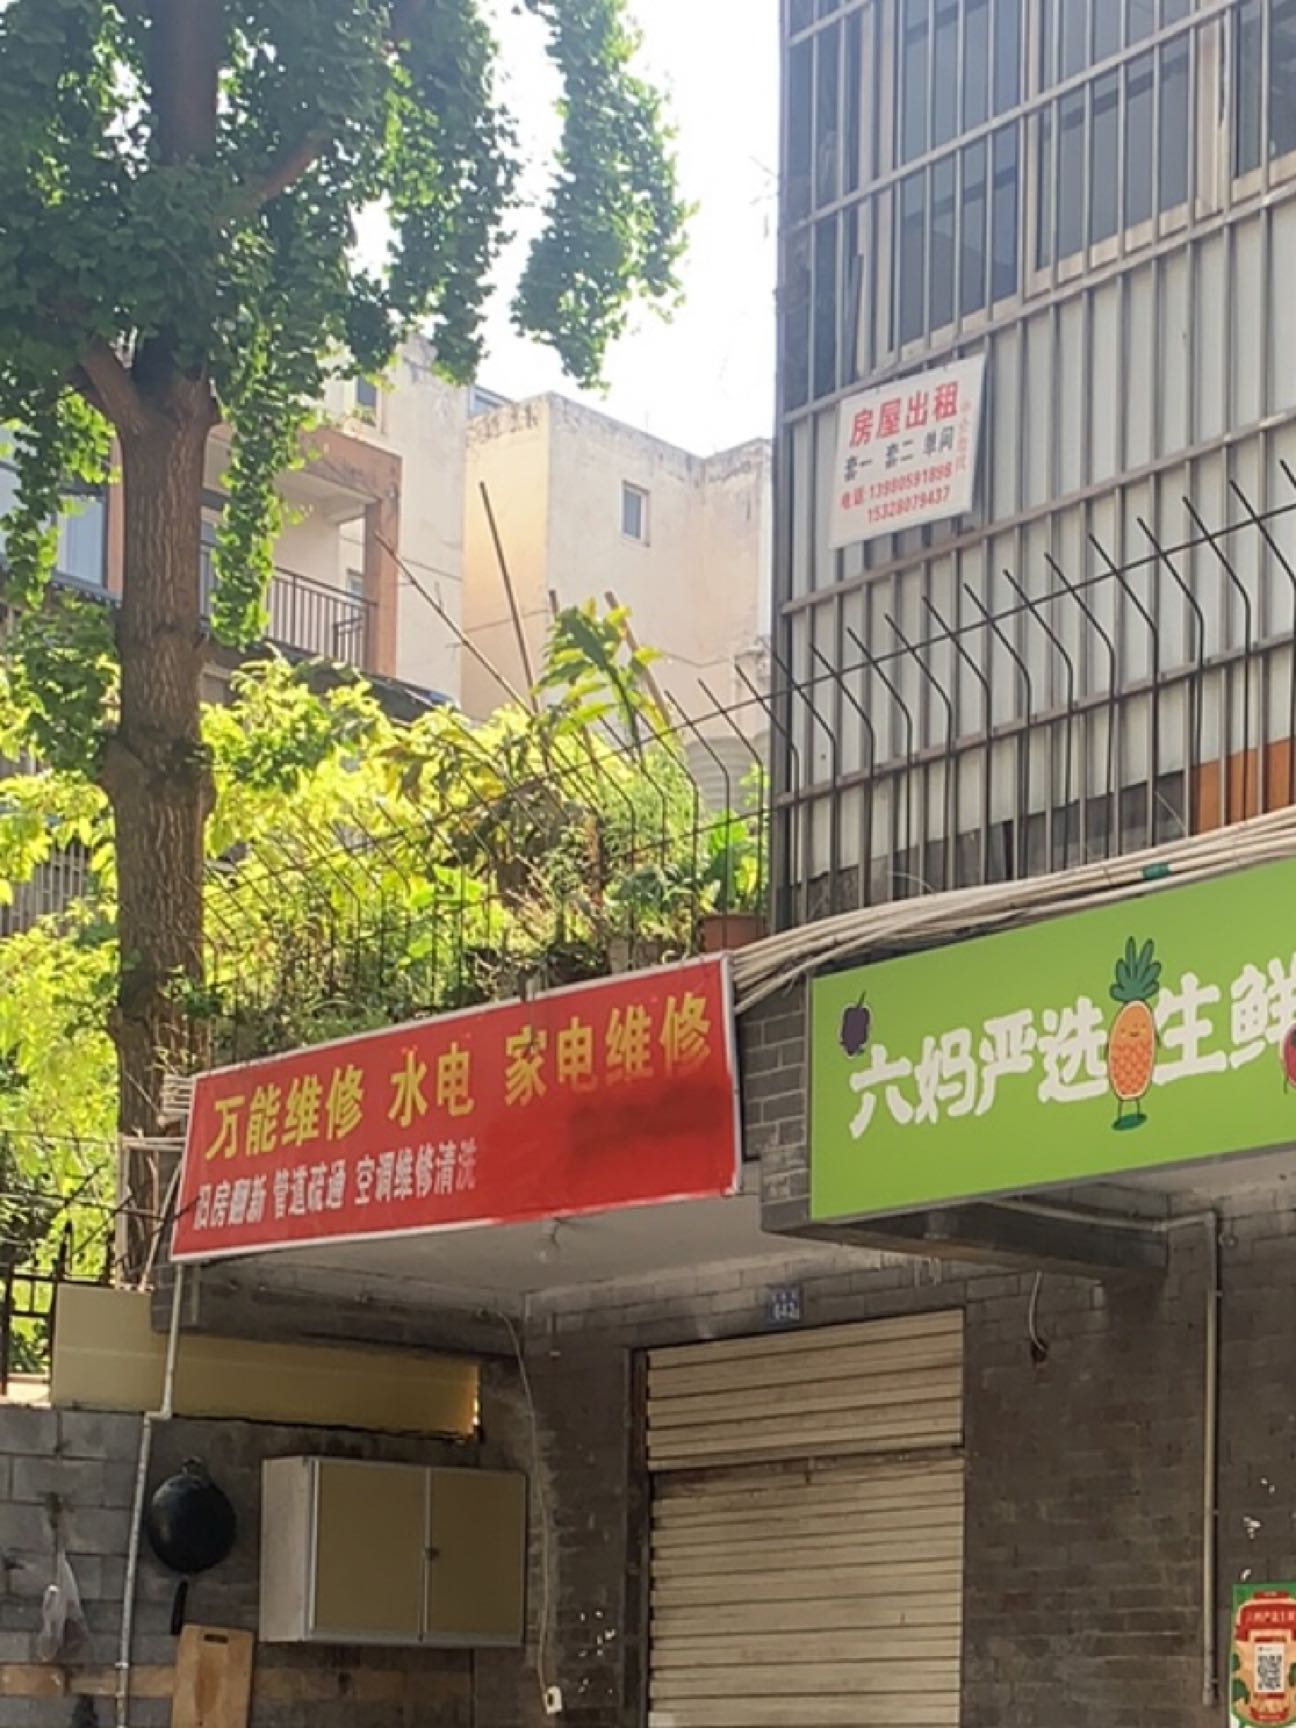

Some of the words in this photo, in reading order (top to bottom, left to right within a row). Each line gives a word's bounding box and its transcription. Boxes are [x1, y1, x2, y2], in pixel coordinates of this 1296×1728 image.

[850, 380, 959, 448] 房屋出租
[204, 1064, 365, 1162] 万能维修
[387, 1041, 476, 1128] 水电
[504, 990, 713, 1108] 家电维修
[848, 994, 1110, 1140] 六妈严选
[273, 1158, 347, 1219] 管道疏通
[354, 1137, 478, 1206] 空调维修清洗
